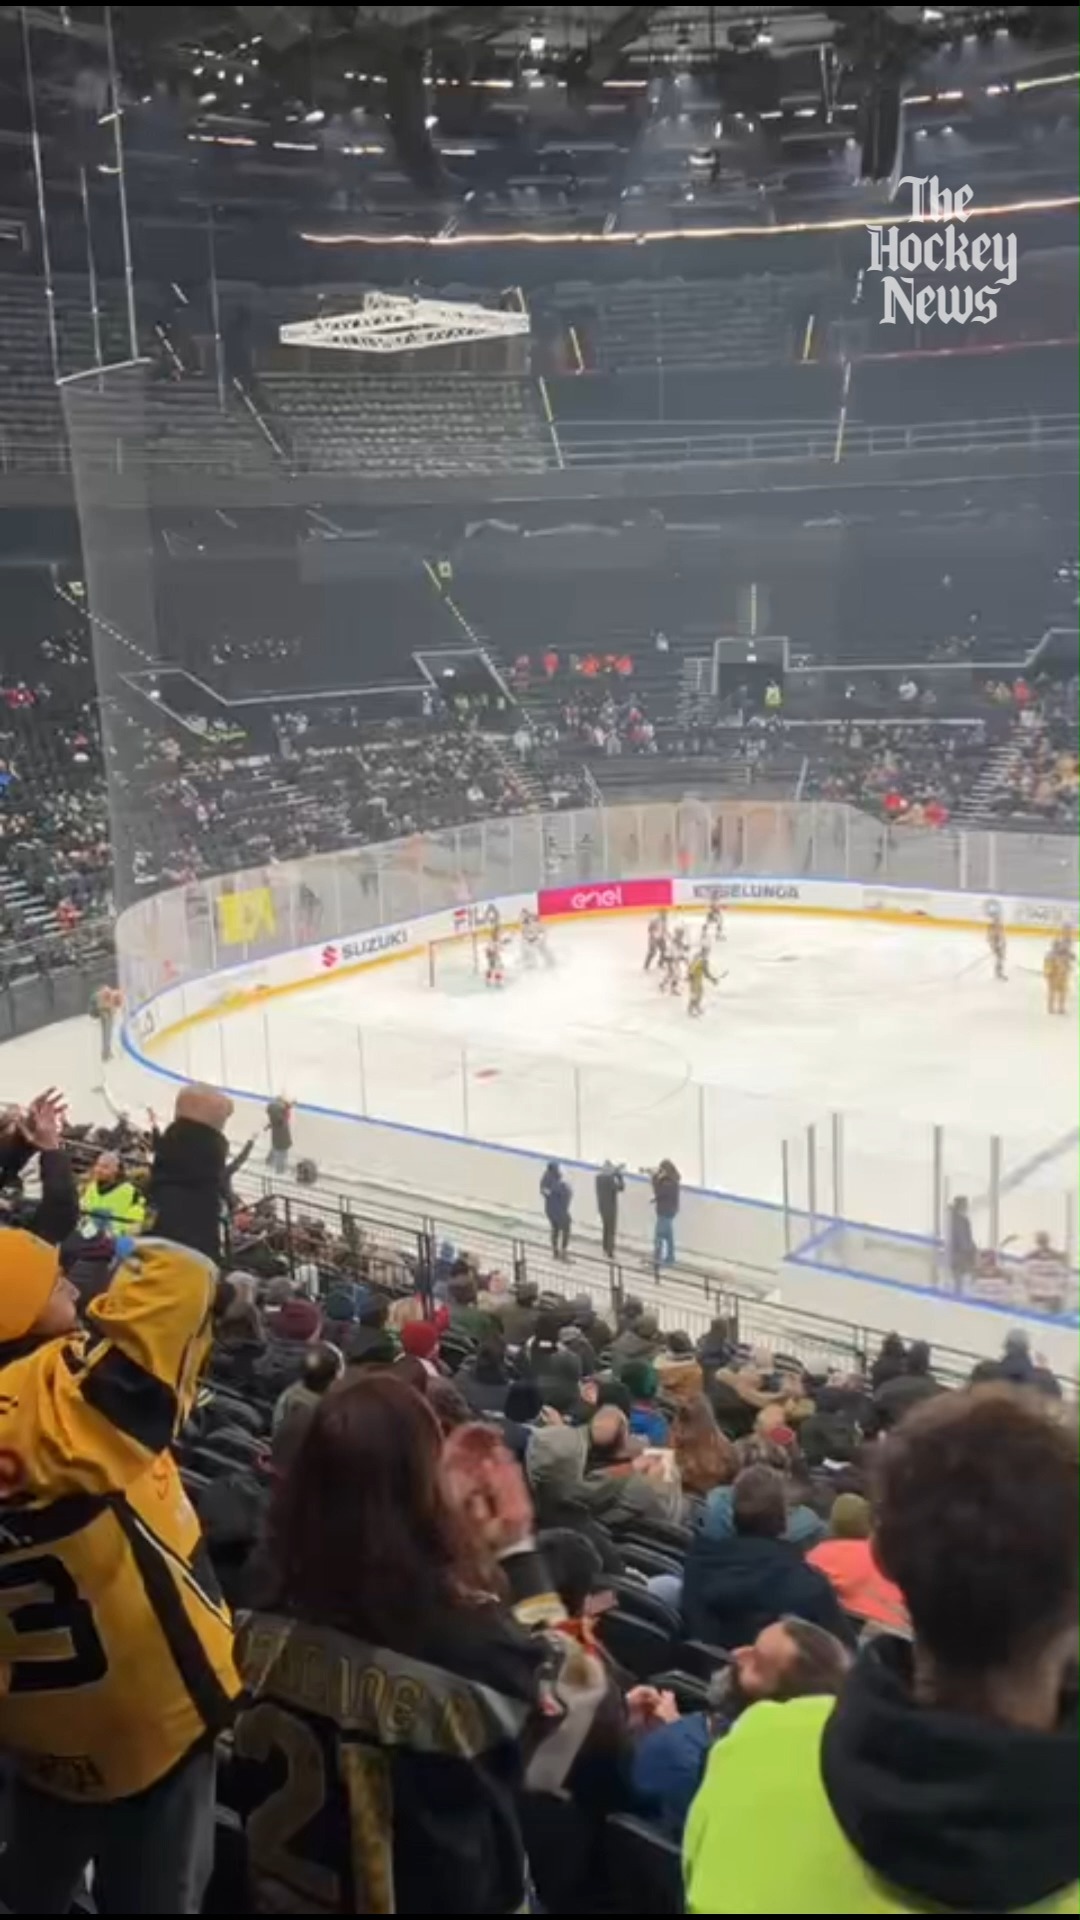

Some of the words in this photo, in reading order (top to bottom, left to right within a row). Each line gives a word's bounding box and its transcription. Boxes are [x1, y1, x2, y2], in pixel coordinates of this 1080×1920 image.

[571, 886, 623, 910] enel
[453, 903, 500, 932] FILA
[342, 929, 408, 960] SUZUKI
